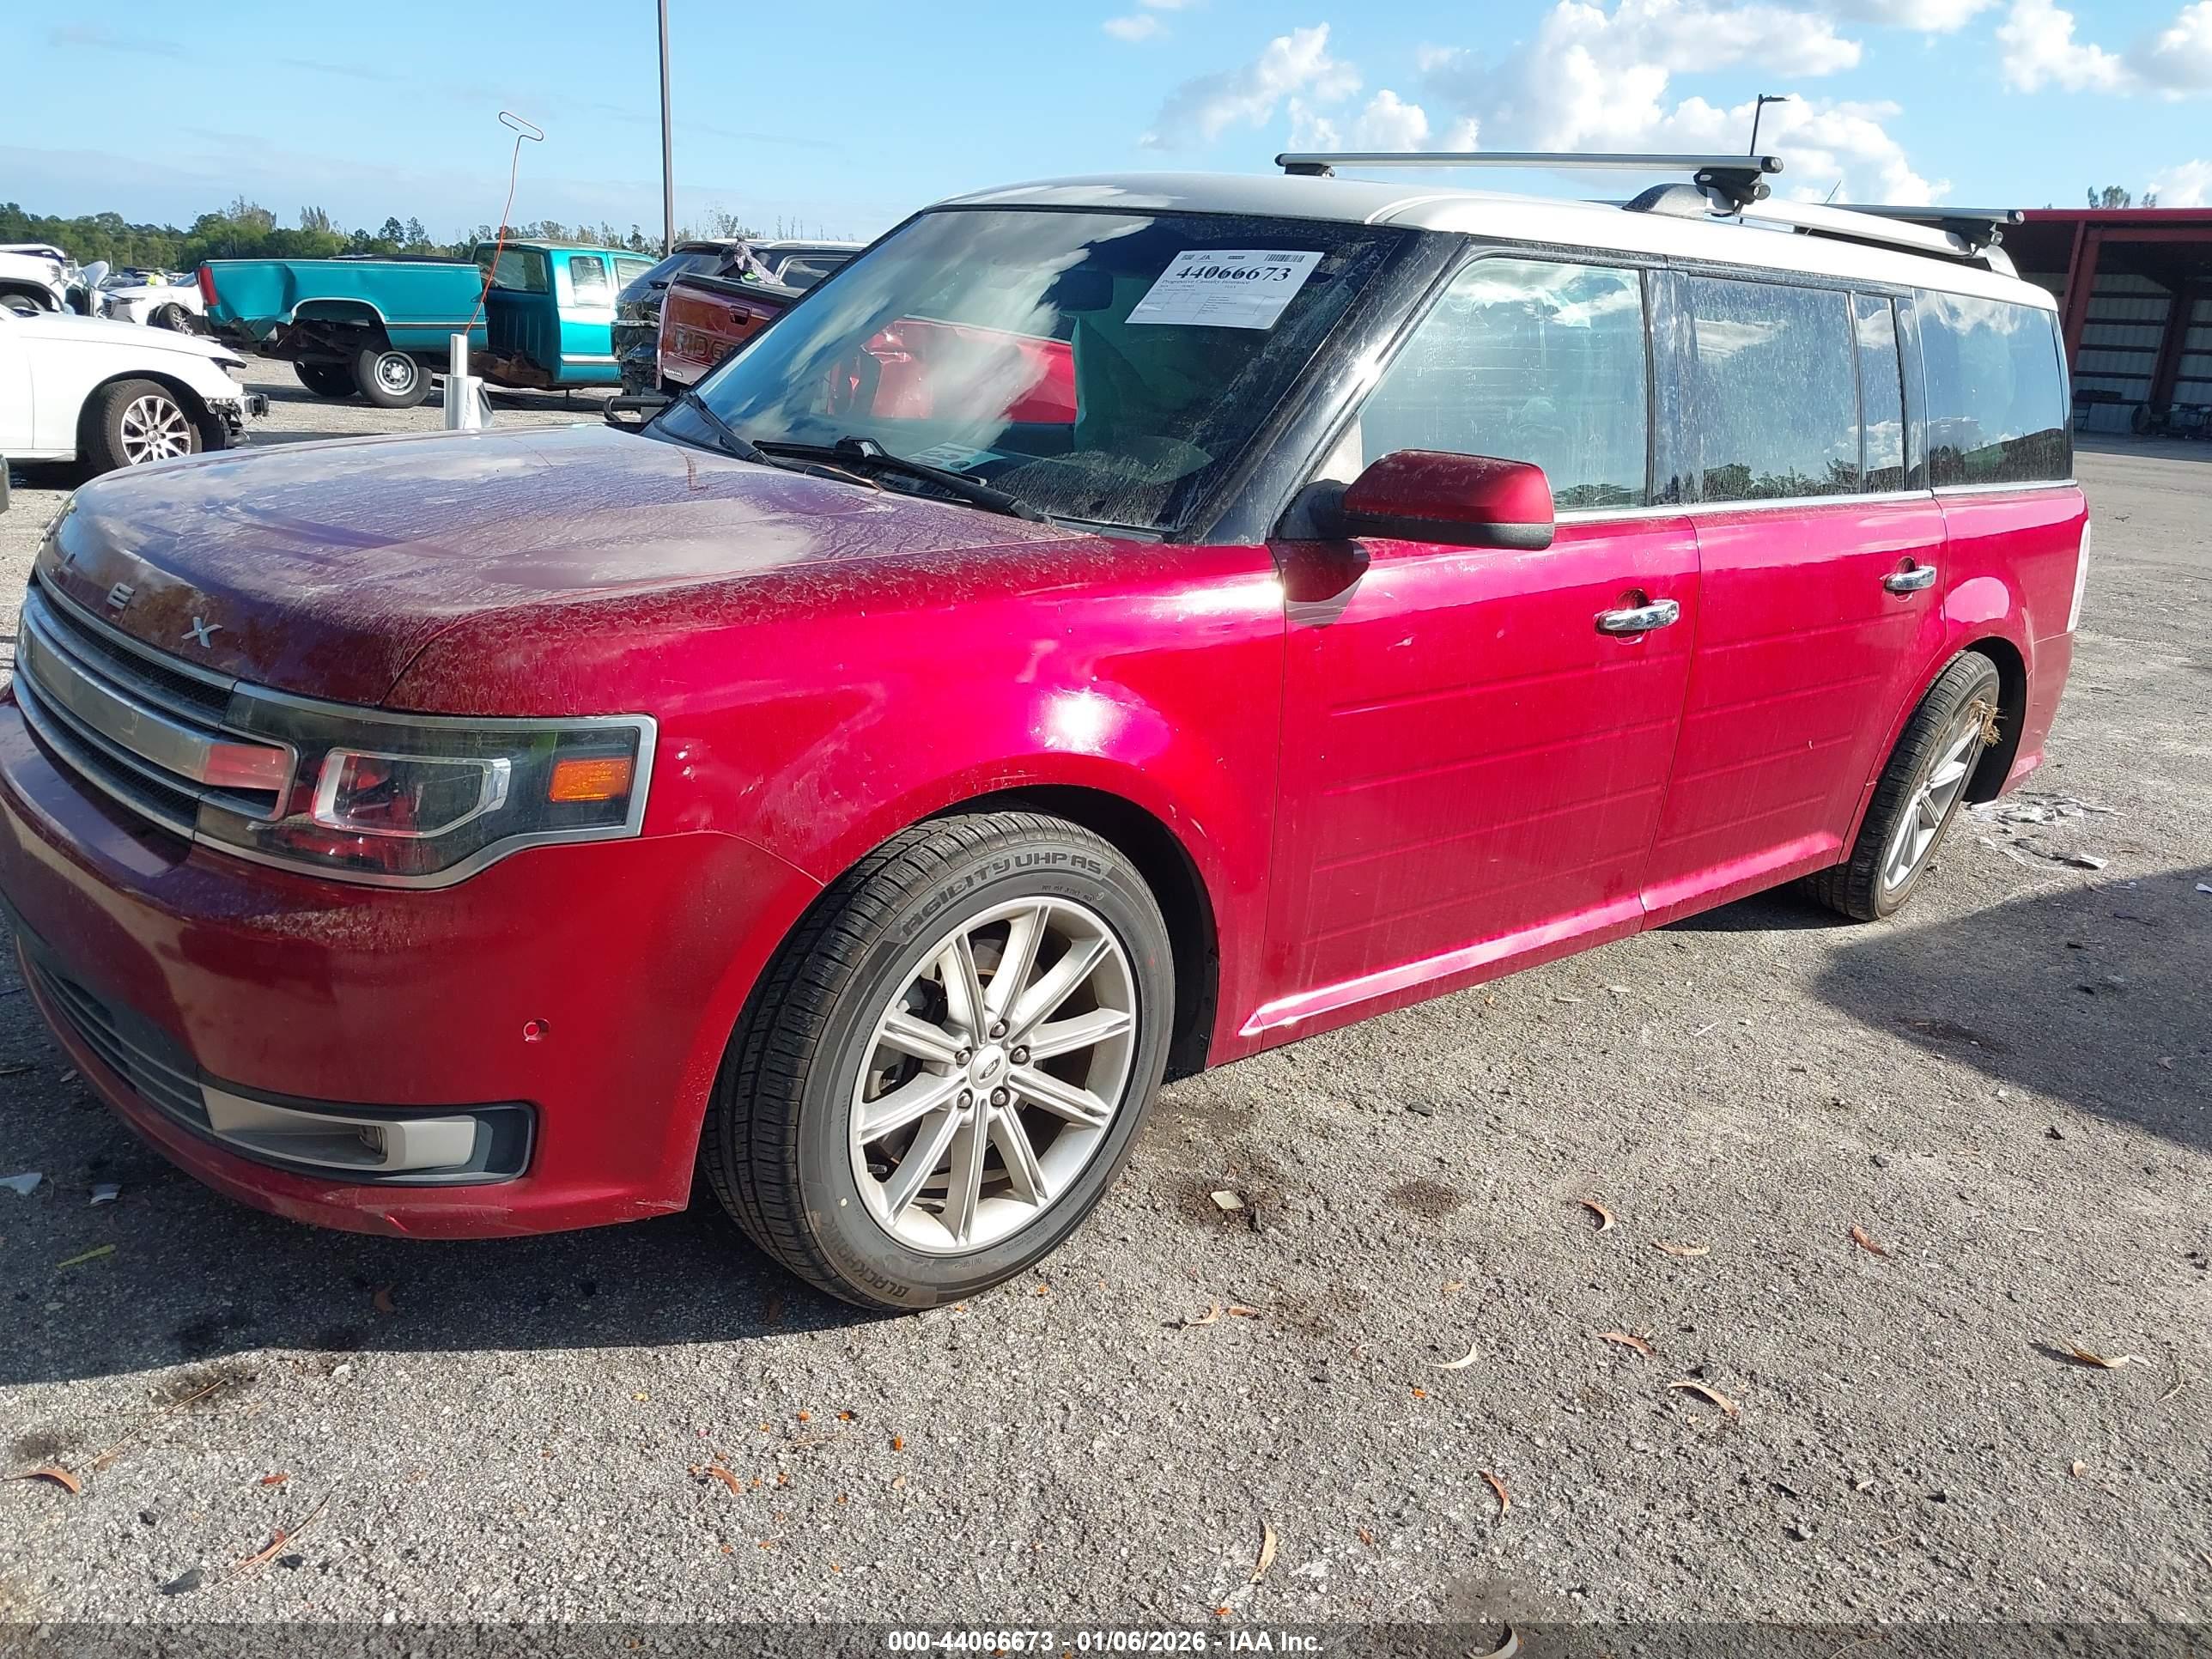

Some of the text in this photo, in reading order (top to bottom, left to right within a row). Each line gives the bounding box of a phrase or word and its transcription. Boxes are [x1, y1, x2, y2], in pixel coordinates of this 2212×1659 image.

[1176, 265, 1292, 282] 44066673
[902, 852, 1103, 939] AGILITY UHP AS
